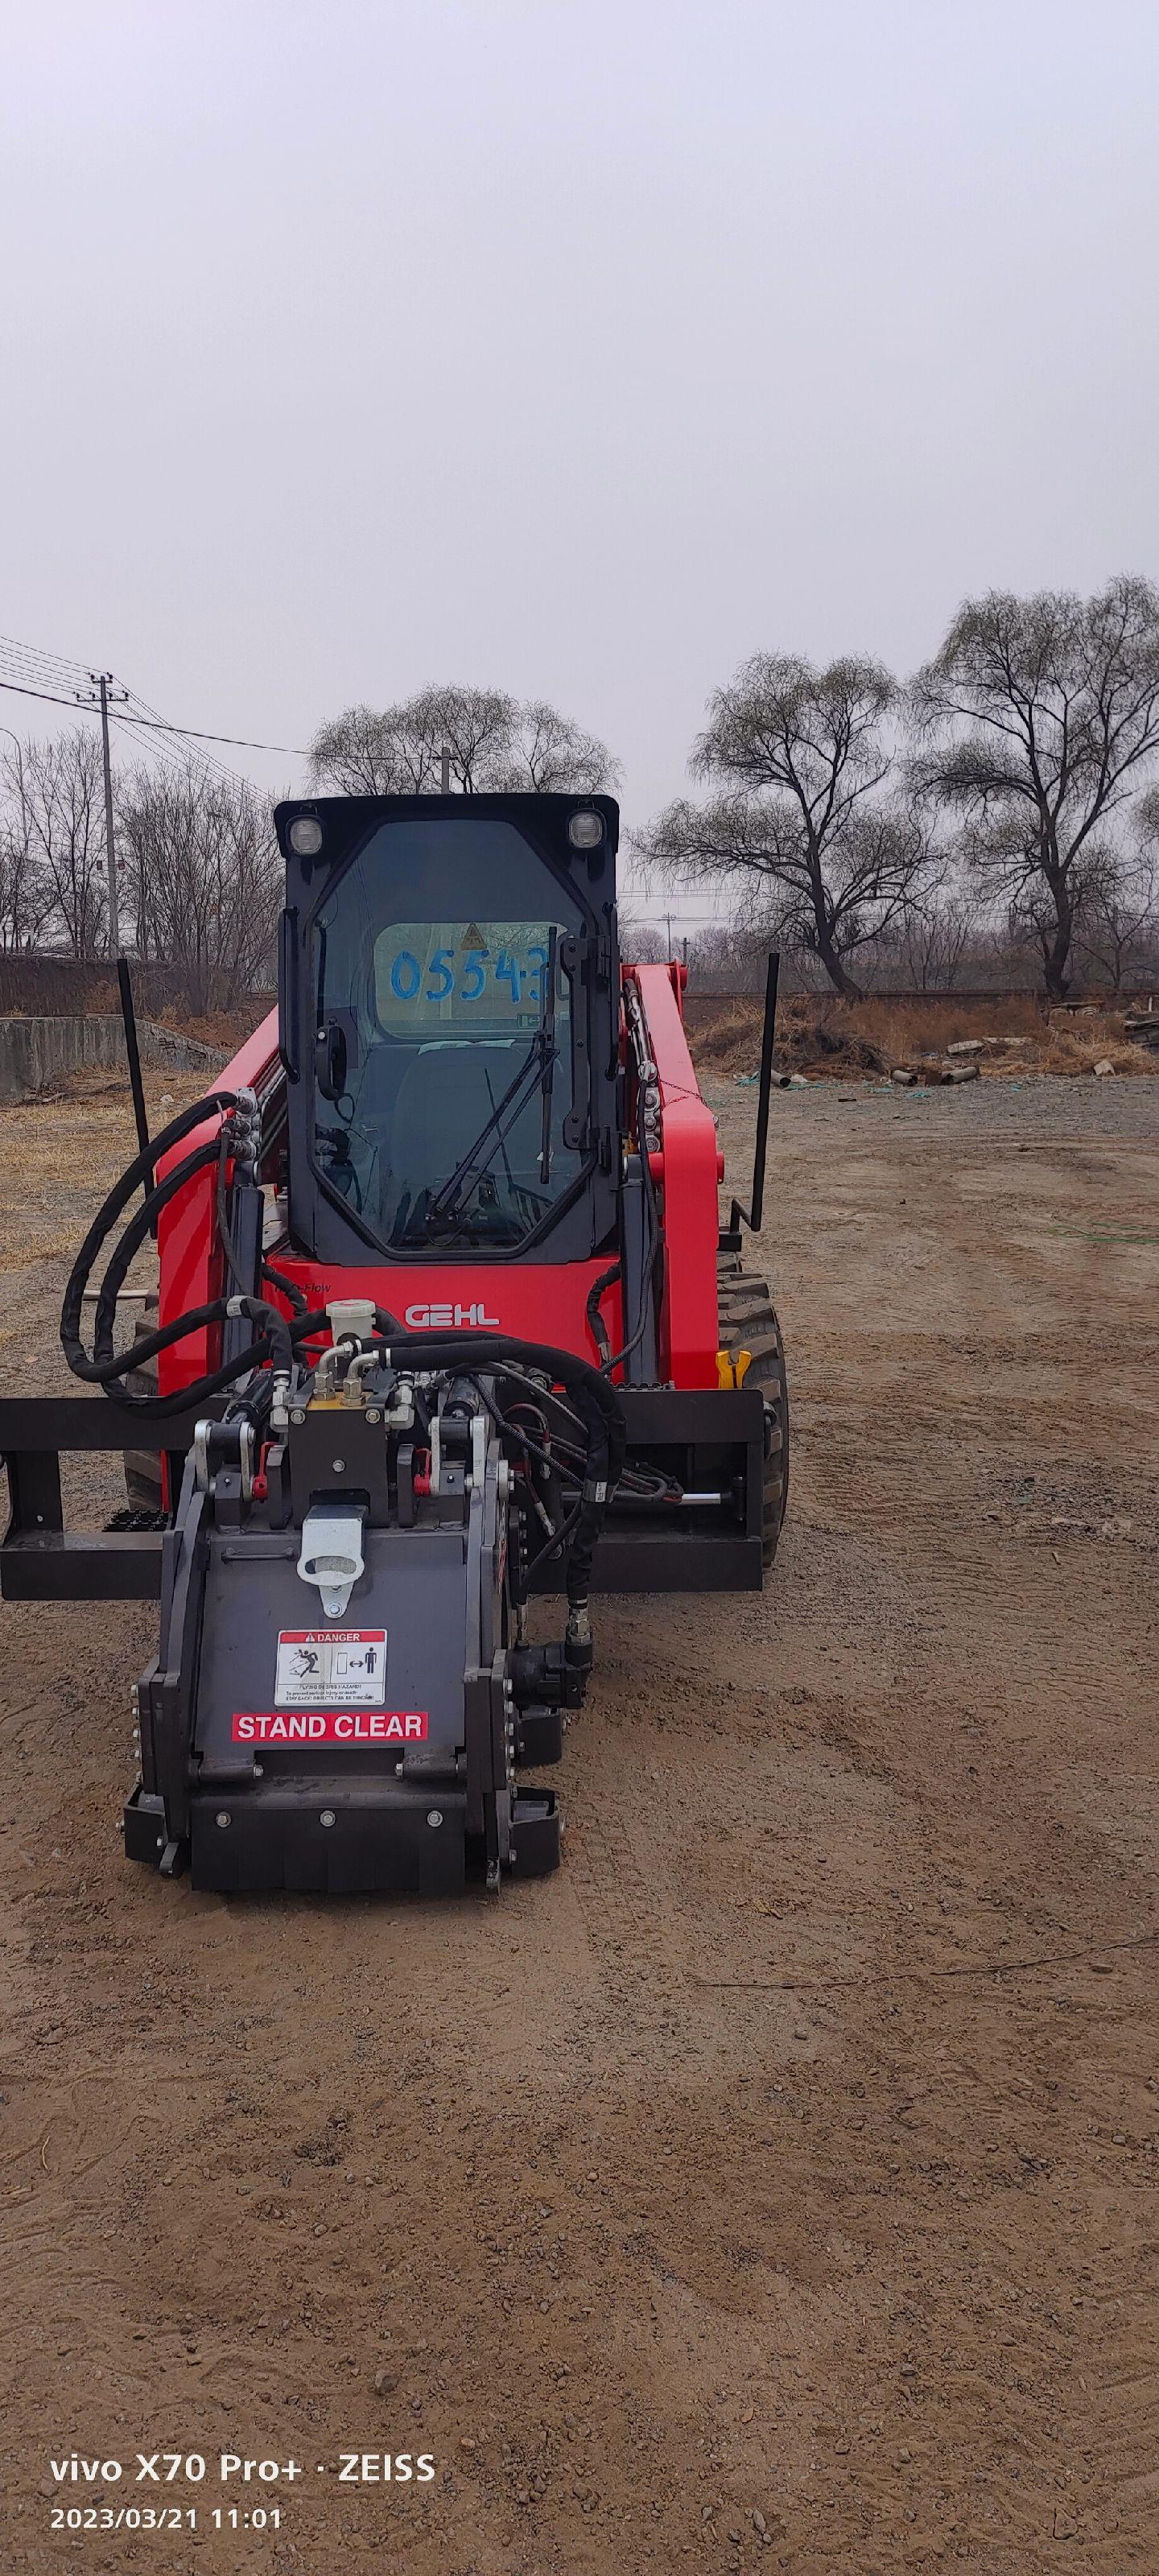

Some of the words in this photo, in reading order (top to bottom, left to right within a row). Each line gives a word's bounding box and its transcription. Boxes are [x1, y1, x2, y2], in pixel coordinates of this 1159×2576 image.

[405, 1303, 500, 1327] GEHL
[317, 1633, 361, 1642] DANGER
[237, 1716, 326, 1738] STAND
[335, 1715, 422, 1737] CLEAR
